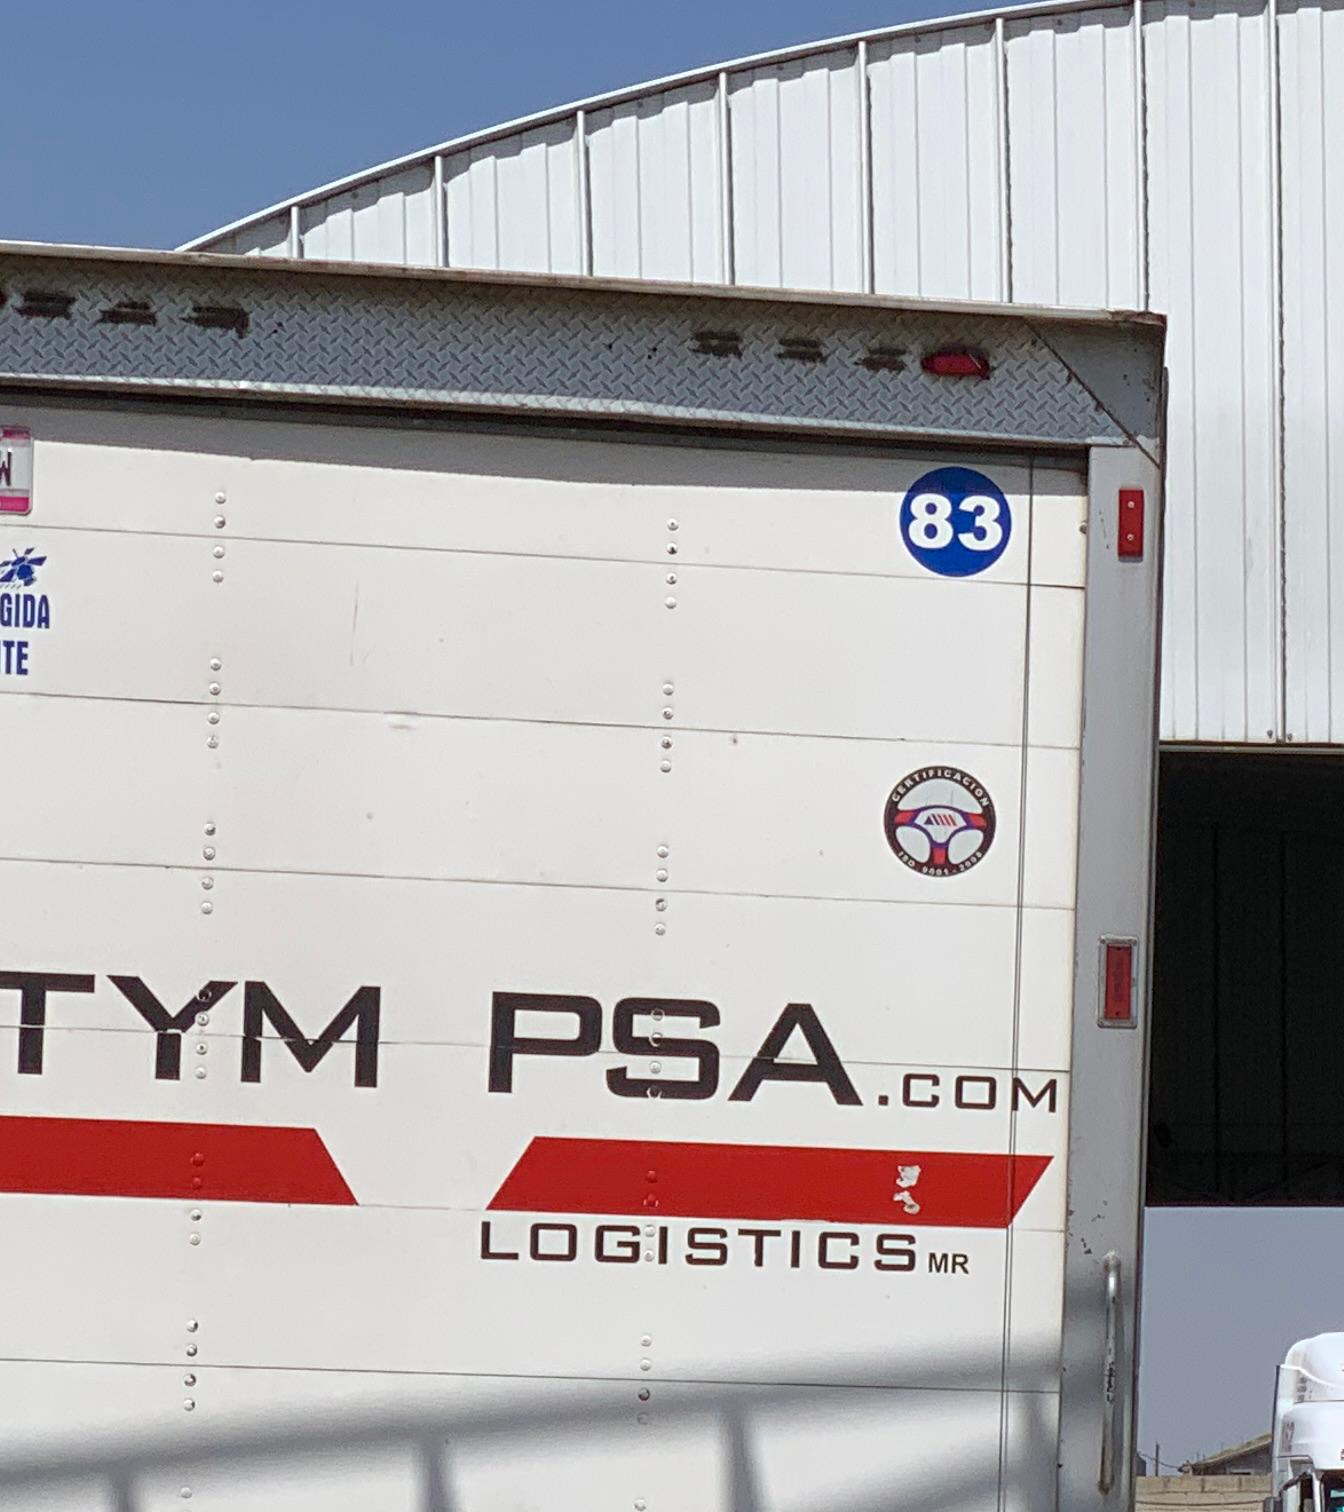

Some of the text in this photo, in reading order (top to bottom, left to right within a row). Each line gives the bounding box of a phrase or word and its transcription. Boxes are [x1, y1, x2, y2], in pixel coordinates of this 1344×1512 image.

[906, 494, 1004, 551] 83
[891, 768, 990, 807] CERTIFICACION
[0, 971, 381, 1089] TYM
[479, 1220, 971, 1275] LOGISTICS MR
